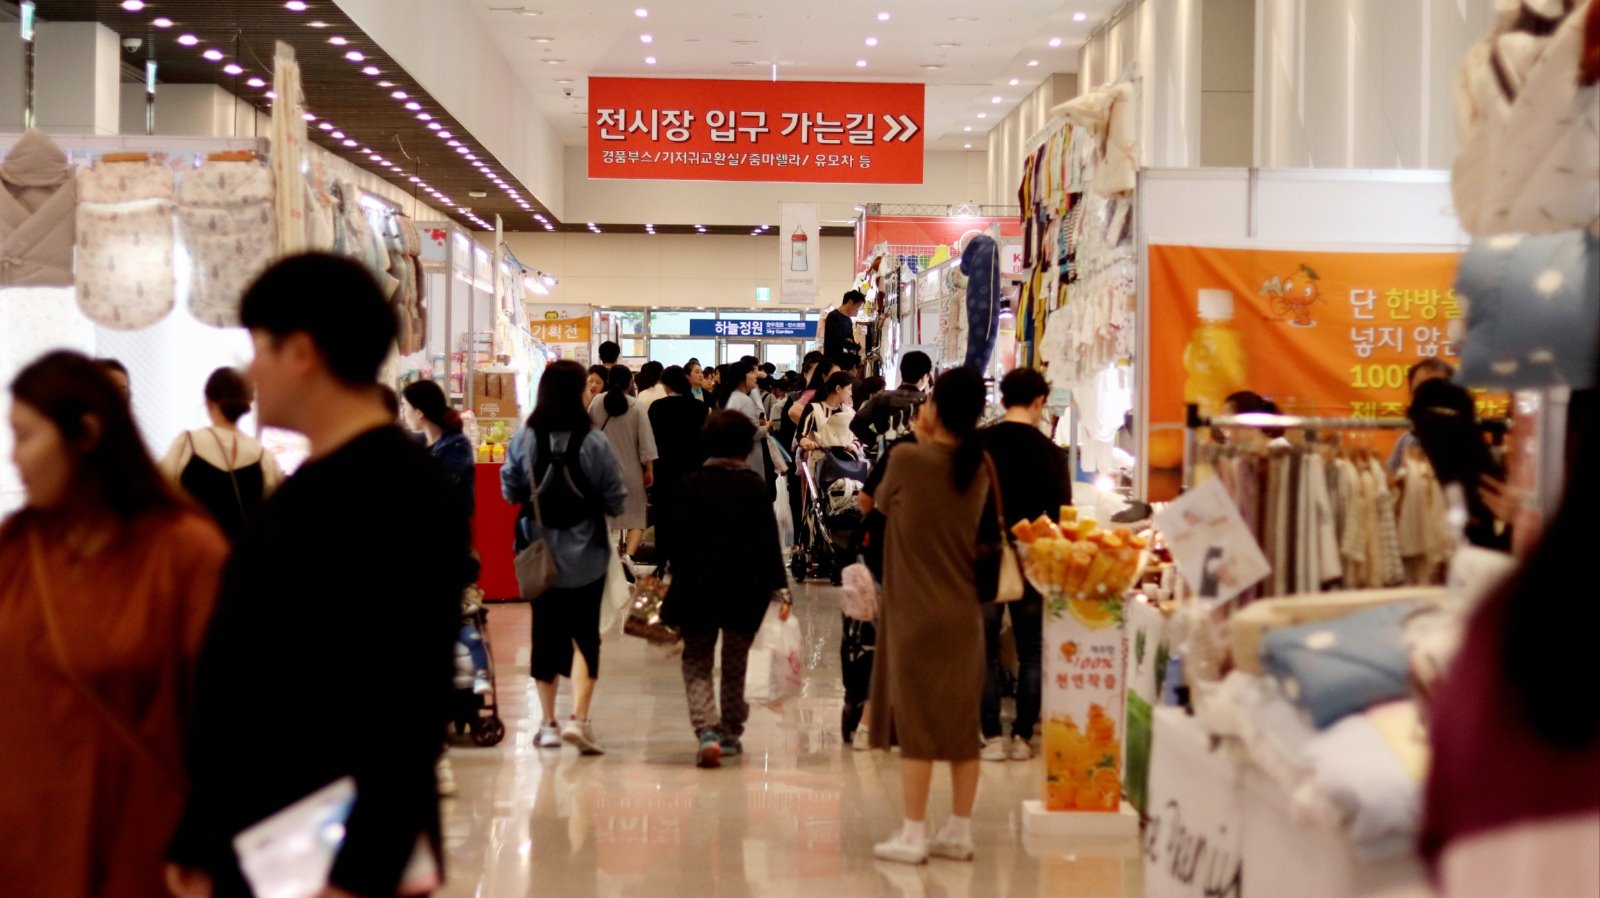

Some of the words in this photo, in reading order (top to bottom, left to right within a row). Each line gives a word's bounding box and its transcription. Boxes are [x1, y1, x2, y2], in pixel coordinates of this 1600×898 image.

[596, 109, 694, 142] 전시장
[705, 110, 769, 142] 입구
[780, 112, 874, 145] 가는길
[814, 154, 854, 168] 유모차
[858, 155, 871, 168] 등
[1350, 289, 1377, 319] 단
[531, 323, 577, 340] 기획전
[715, 321, 763, 335] 하늘정원
[1350, 327, 1402, 357] 넣지
